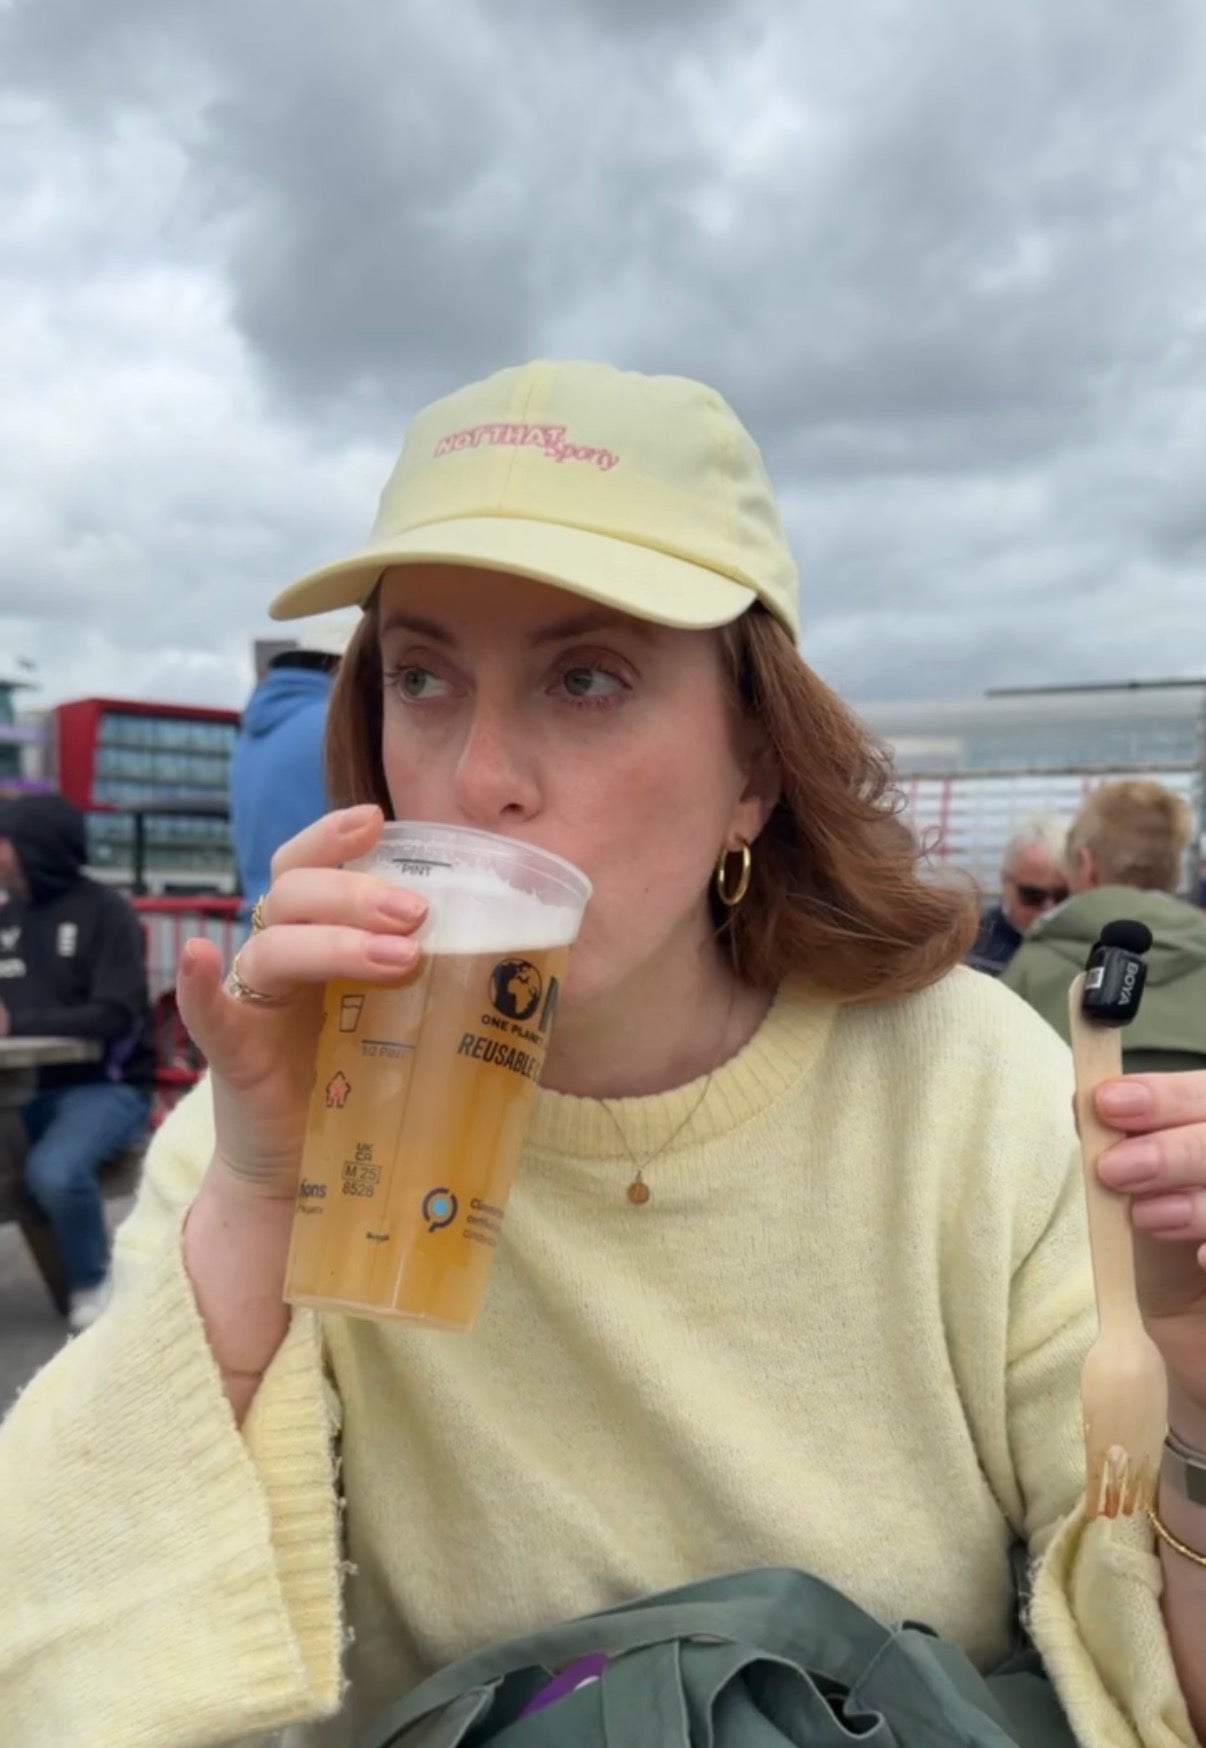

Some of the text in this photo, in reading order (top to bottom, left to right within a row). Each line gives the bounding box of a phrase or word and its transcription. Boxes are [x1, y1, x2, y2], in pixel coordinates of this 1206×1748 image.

[434, 425, 487, 458] NOT
[484, 423, 567, 448] THAT
[401, 864, 432, 877] PINT
[1118, 961, 1139, 1005] BOYA
[481, 1014, 509, 1031] ONE
